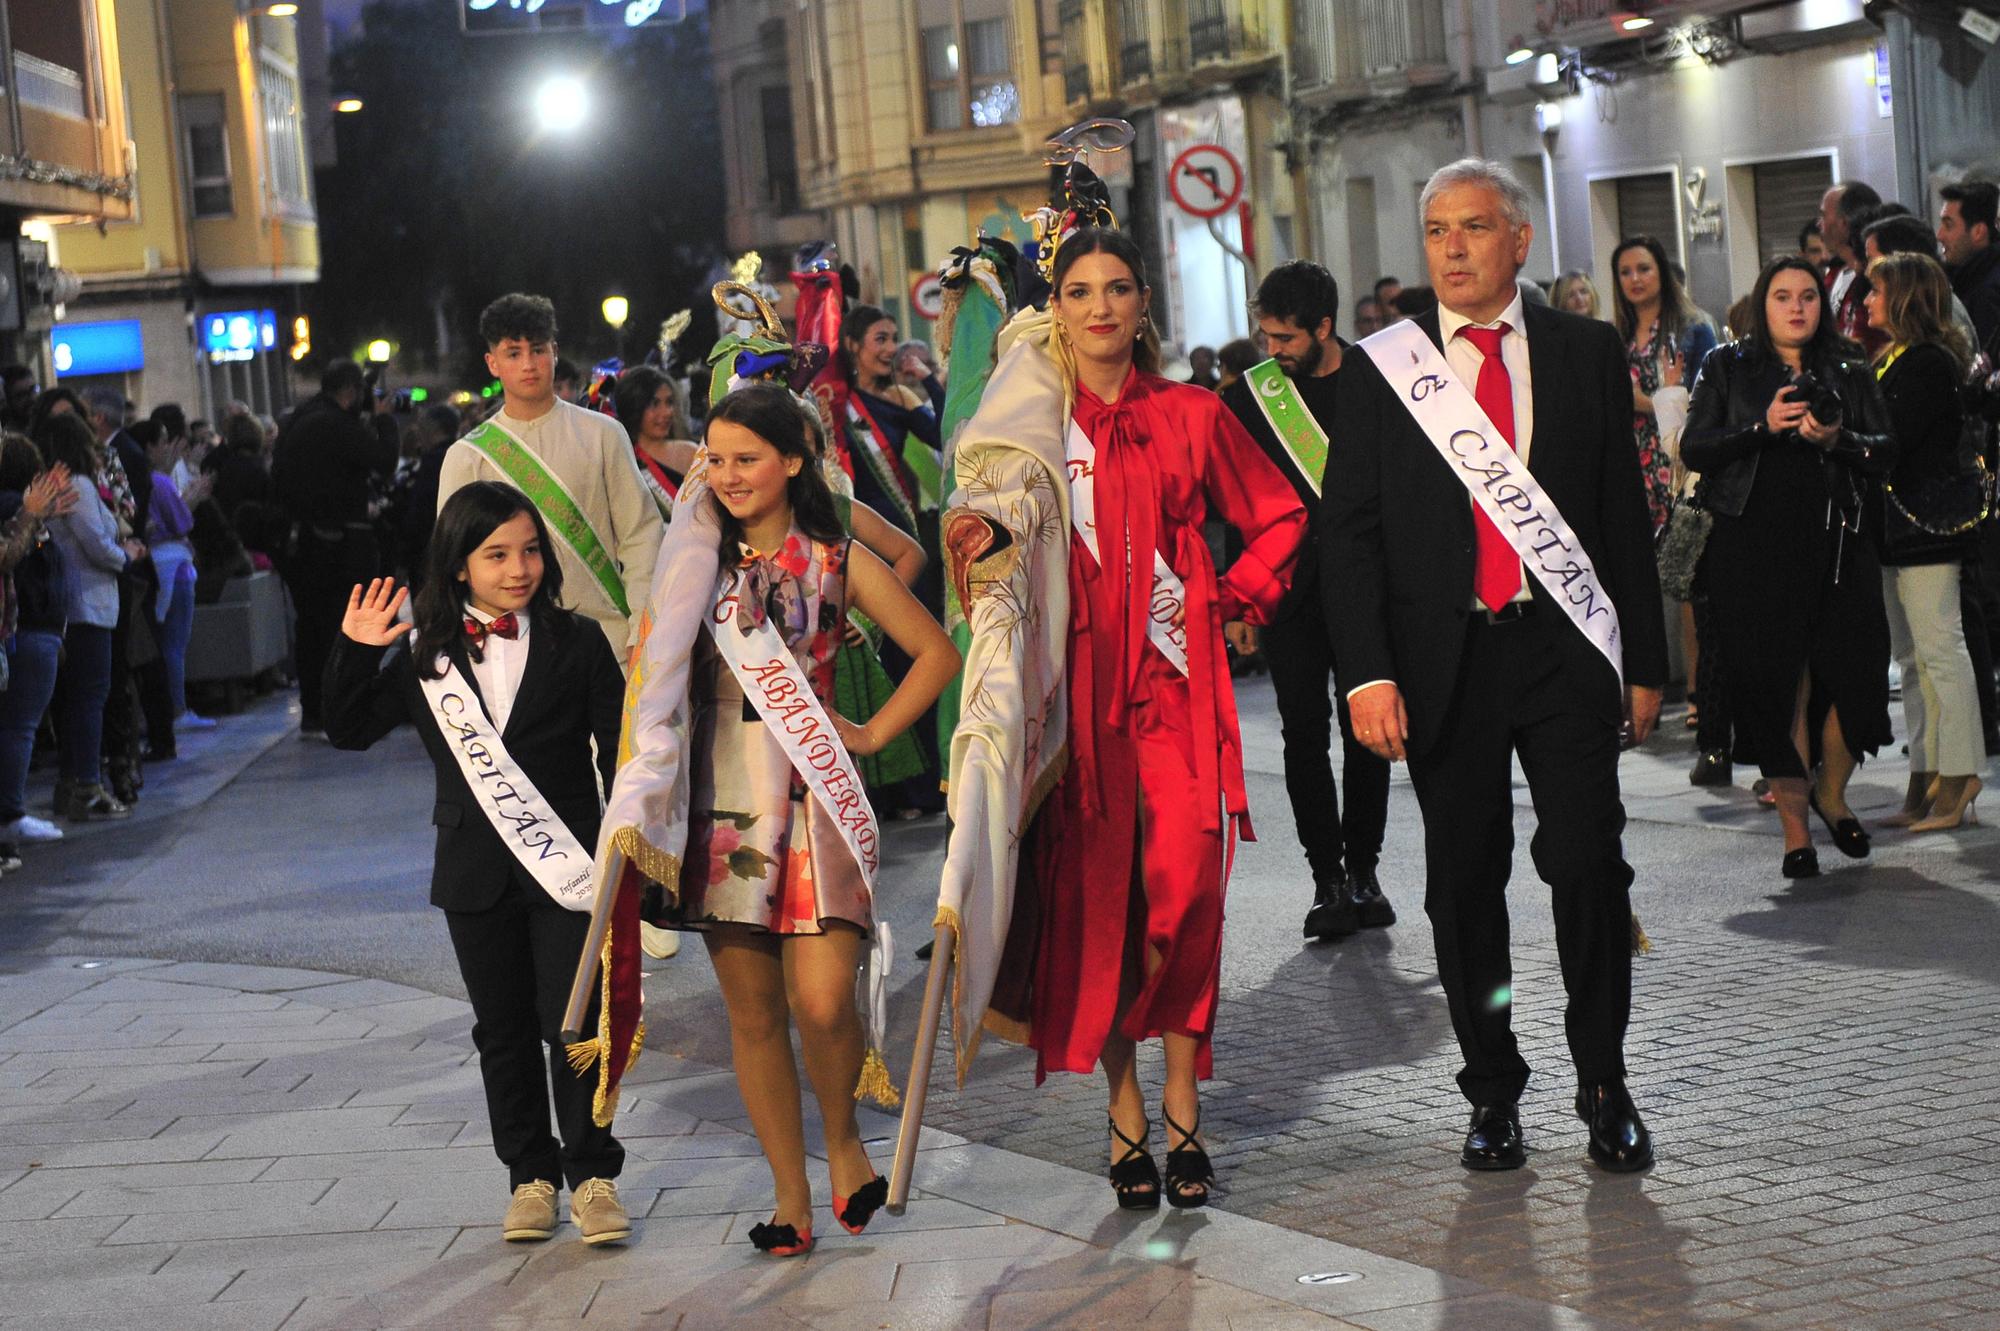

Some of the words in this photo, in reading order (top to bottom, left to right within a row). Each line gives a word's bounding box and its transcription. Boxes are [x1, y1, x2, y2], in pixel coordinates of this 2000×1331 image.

[1449, 428, 1609, 622] CAPITÁN
[441, 693, 568, 861] CAPITÁN
[742, 659, 878, 875] ABANDERADA
[560, 867, 590, 895] Infantil
